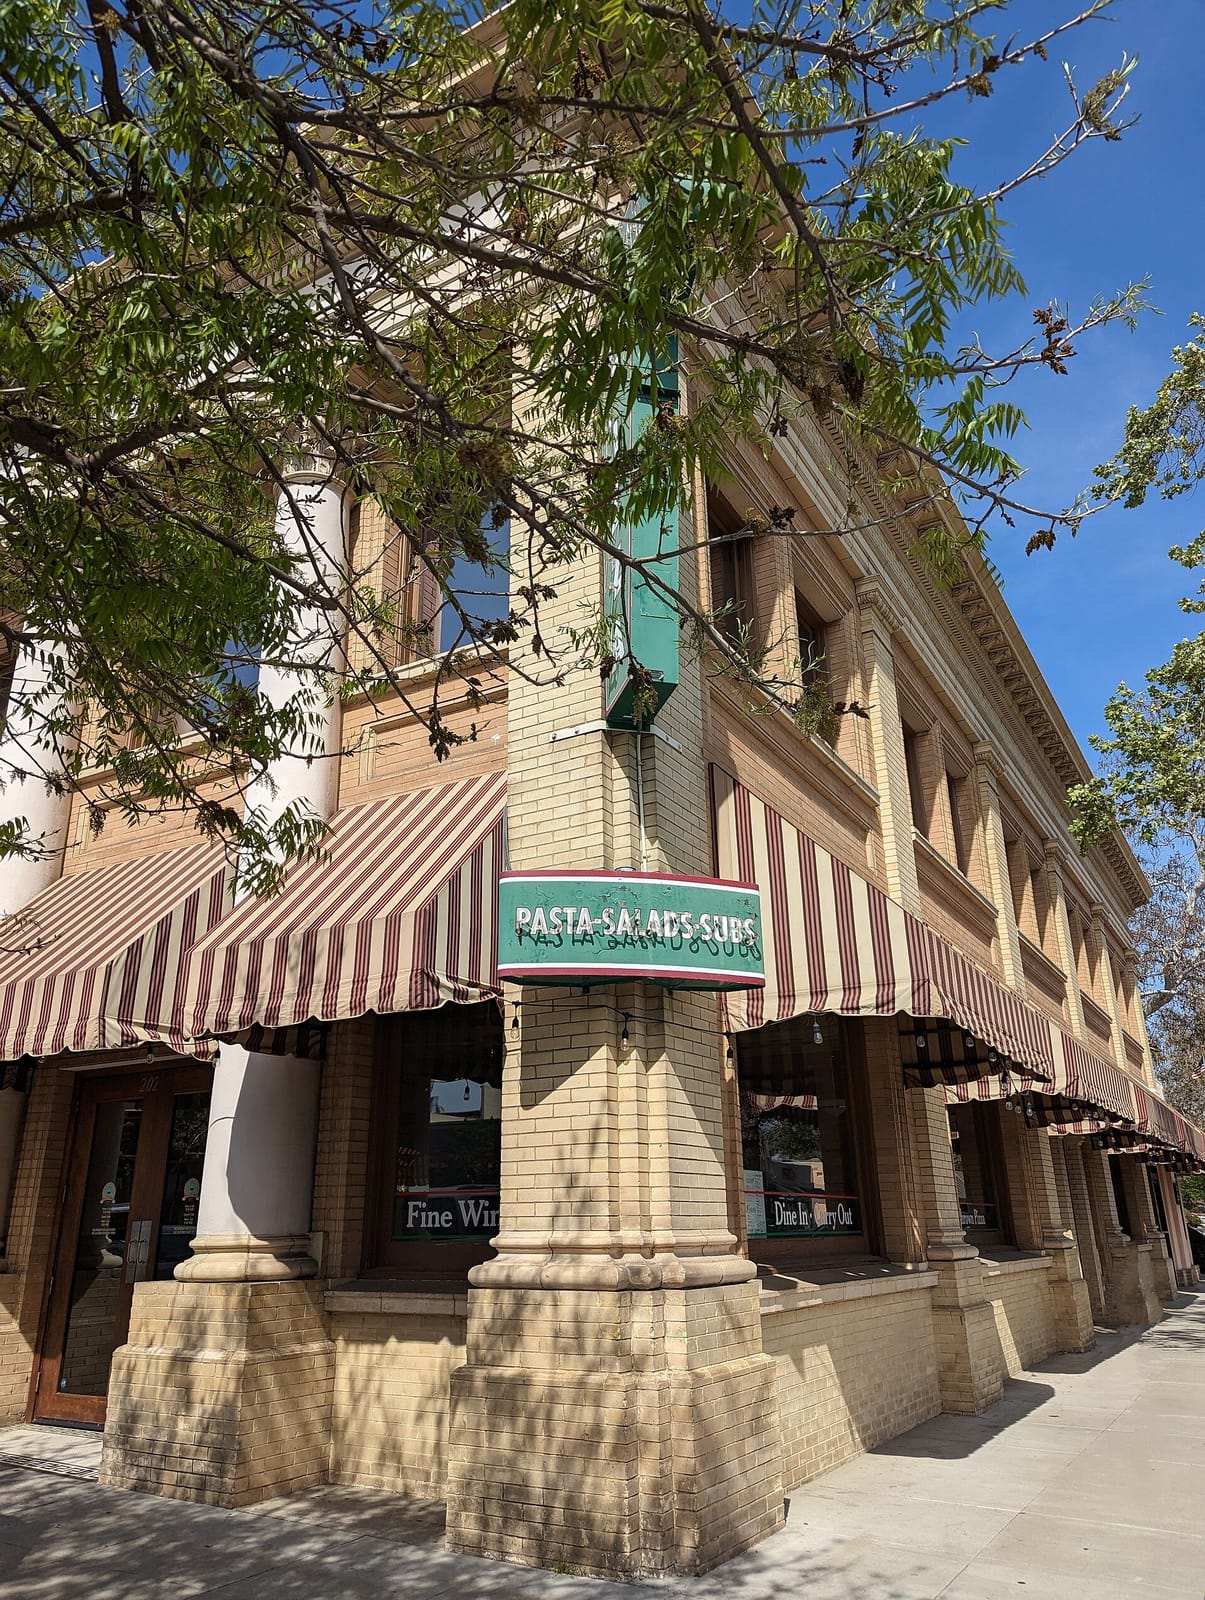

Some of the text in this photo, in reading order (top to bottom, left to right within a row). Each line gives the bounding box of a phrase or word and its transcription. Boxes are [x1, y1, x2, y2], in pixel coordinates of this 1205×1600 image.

[406, 1201, 453, 1228] Fine
[774, 1201, 853, 1230] Dine In Crry Out
